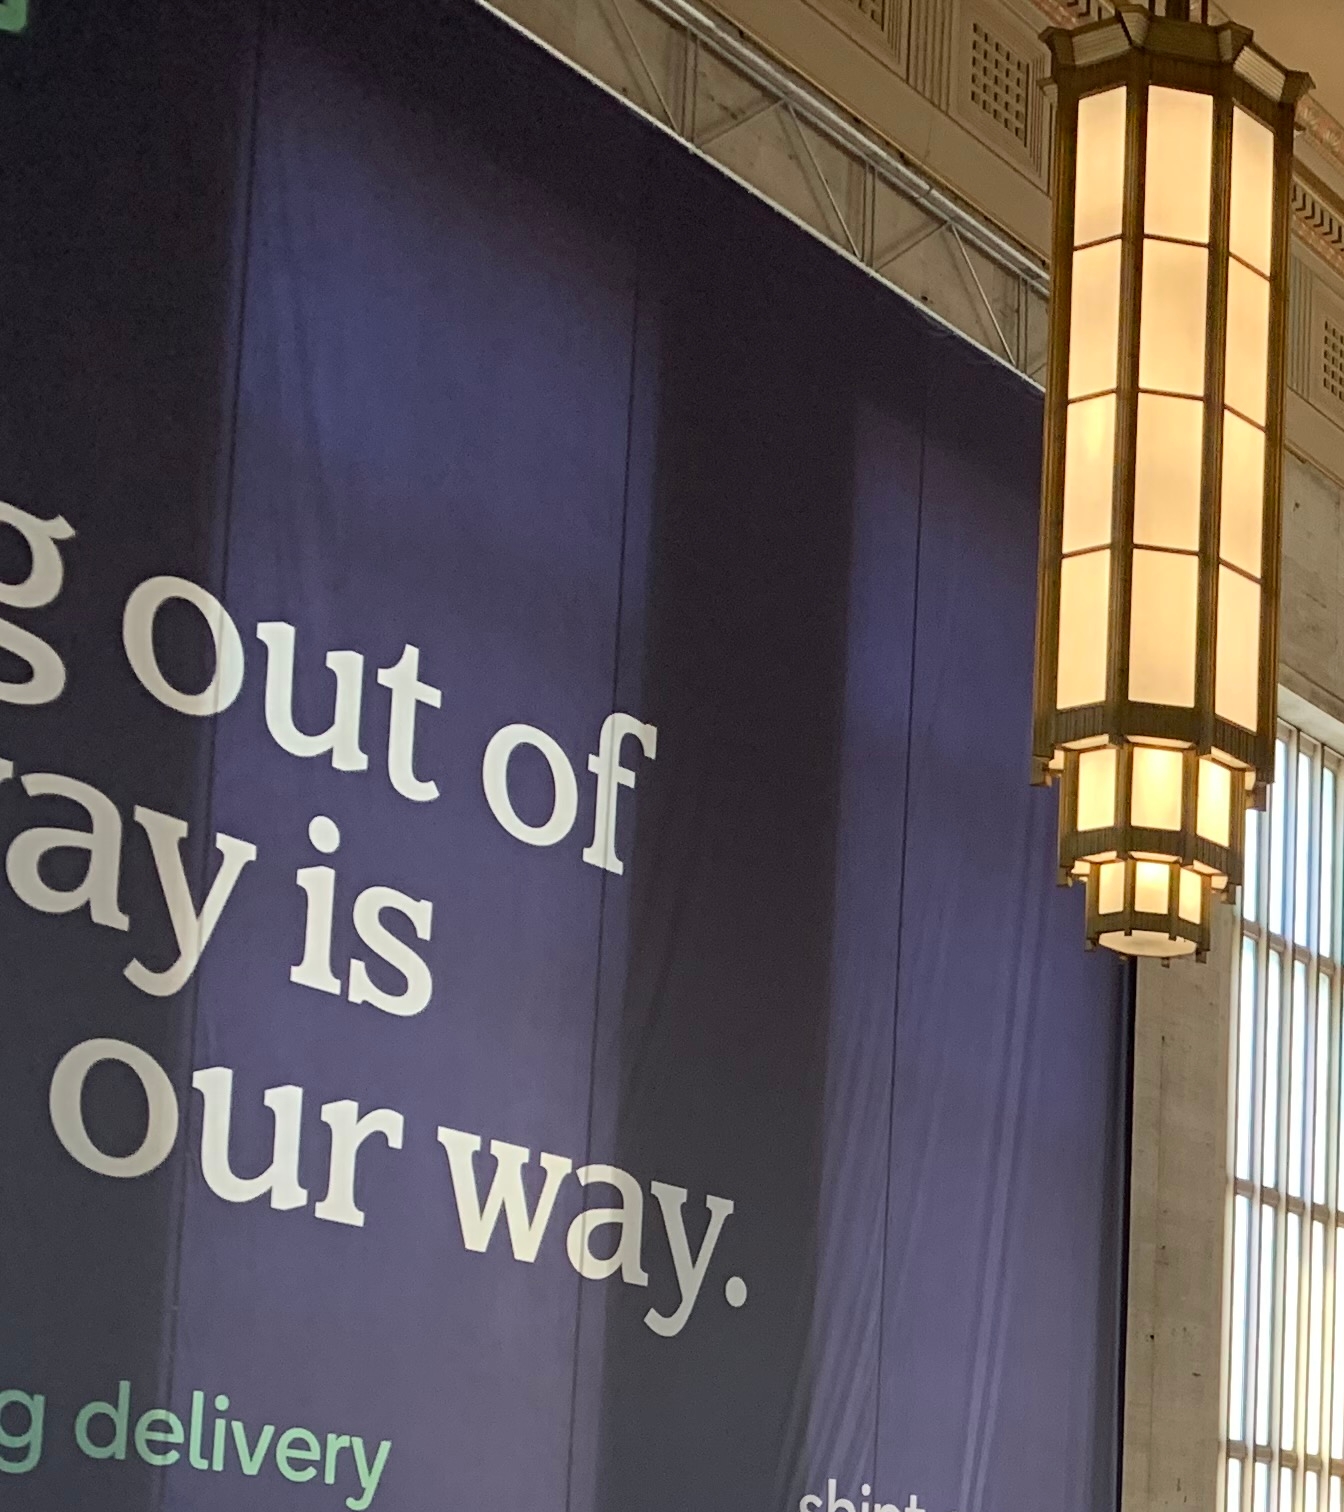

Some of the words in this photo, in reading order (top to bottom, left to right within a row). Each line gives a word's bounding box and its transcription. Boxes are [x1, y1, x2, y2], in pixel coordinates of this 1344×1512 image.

[122, 575, 442, 801] out
[483, 713, 657, 875] of
[0, 757, 256, 998] ay
[290, 816, 433, 1017] is
[49, 1037, 403, 1229] our
[438, 1125, 748, 1337] way.
[74, 1381, 392, 1511] delivery
